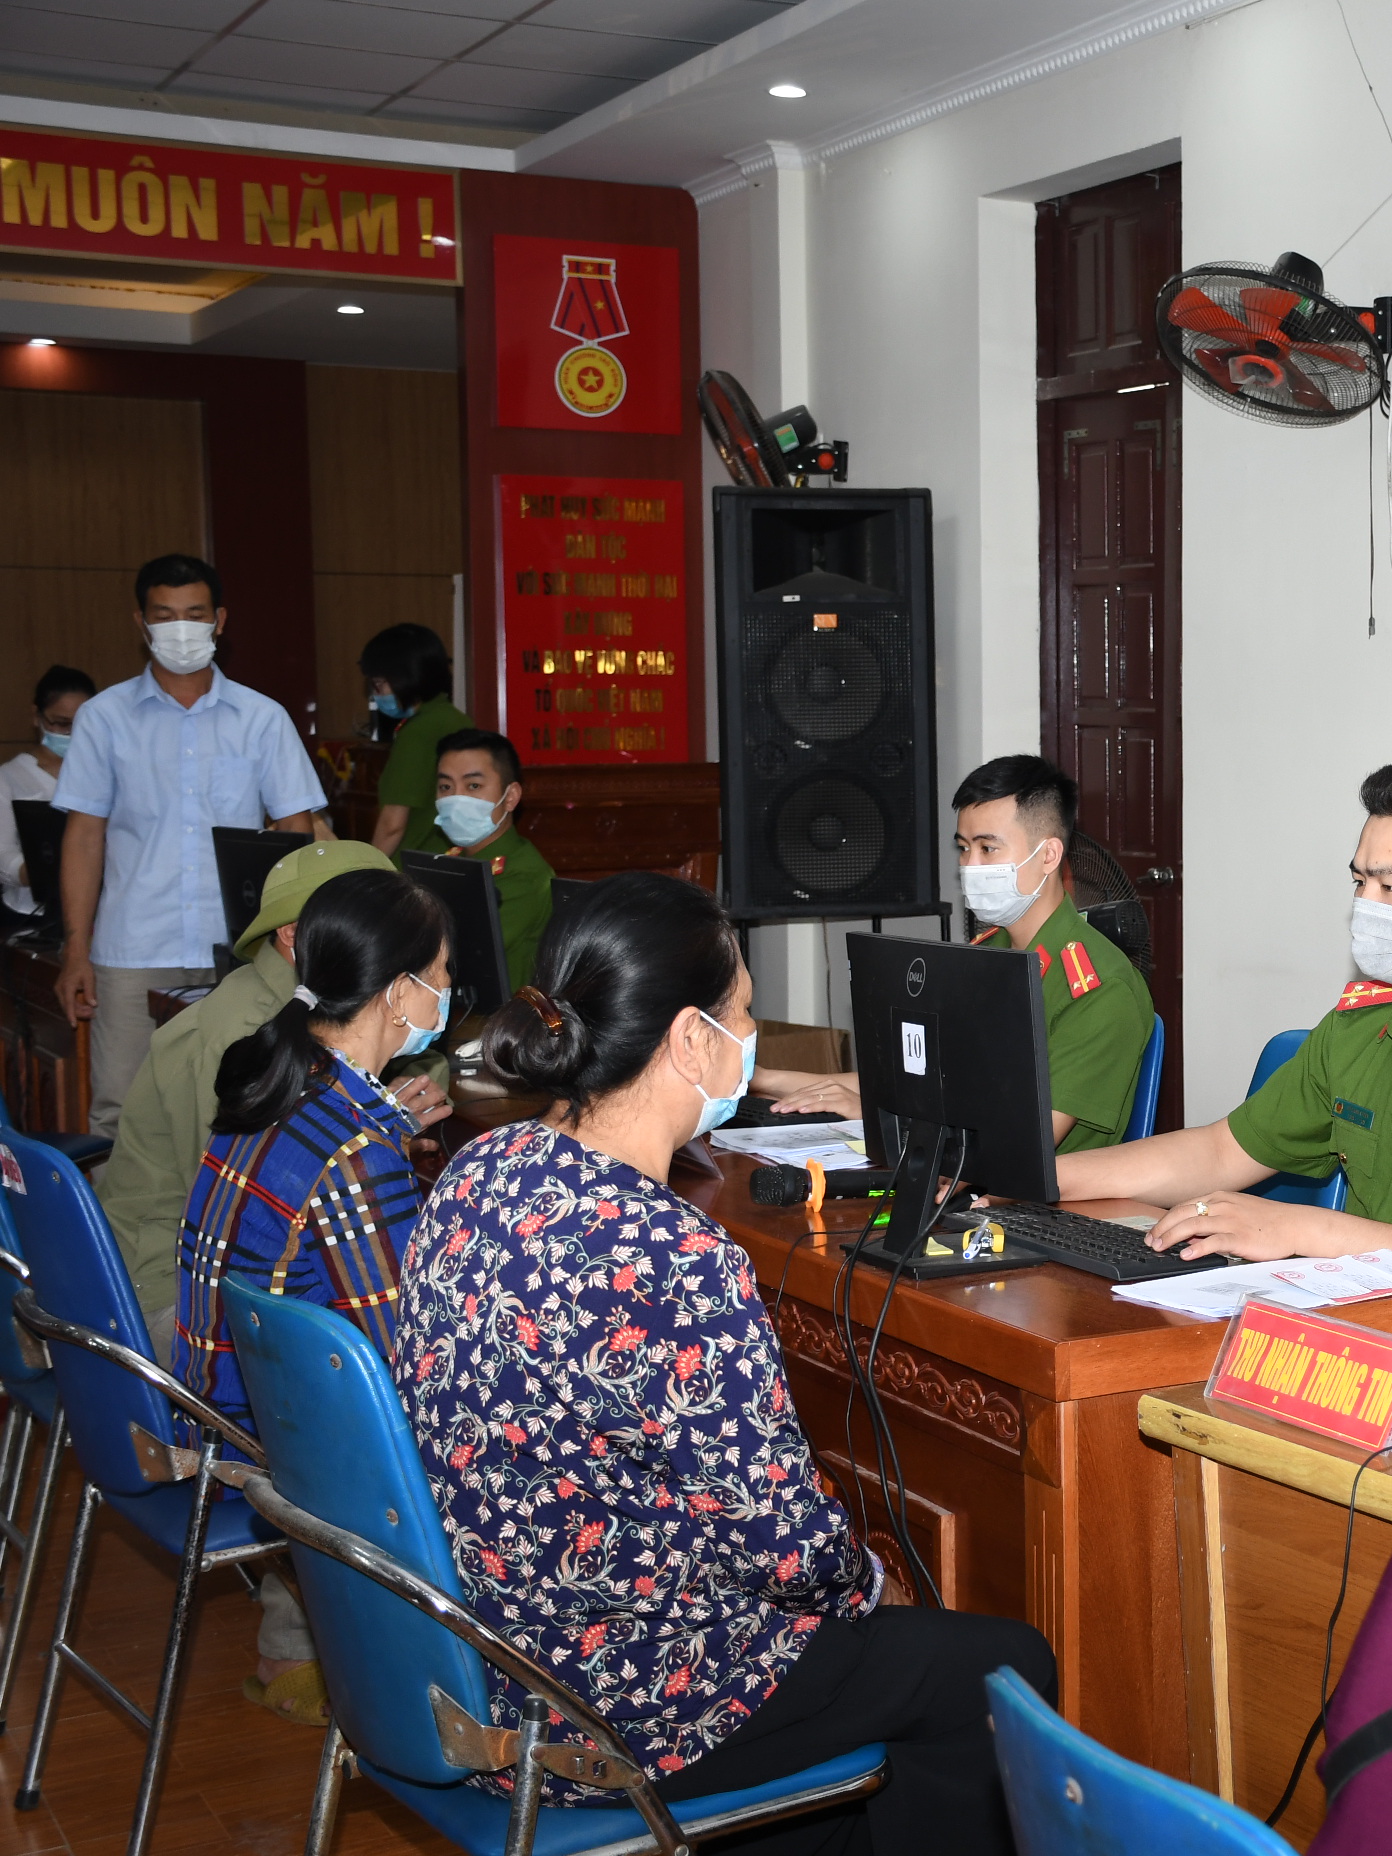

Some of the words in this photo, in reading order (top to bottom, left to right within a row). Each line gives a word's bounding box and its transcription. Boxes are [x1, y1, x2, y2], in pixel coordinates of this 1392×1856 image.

[0, 155, 218, 242] MUÔN
[242, 173, 399, 256] NĂM
[908, 971, 923, 983] DELL
[906, 1033, 922, 1059] 10
[1227, 1328, 1270, 1382] THU
[1255, 1333, 1315, 1404] NHẬN
[1302, 1347, 1369, 1415] THÔNG
